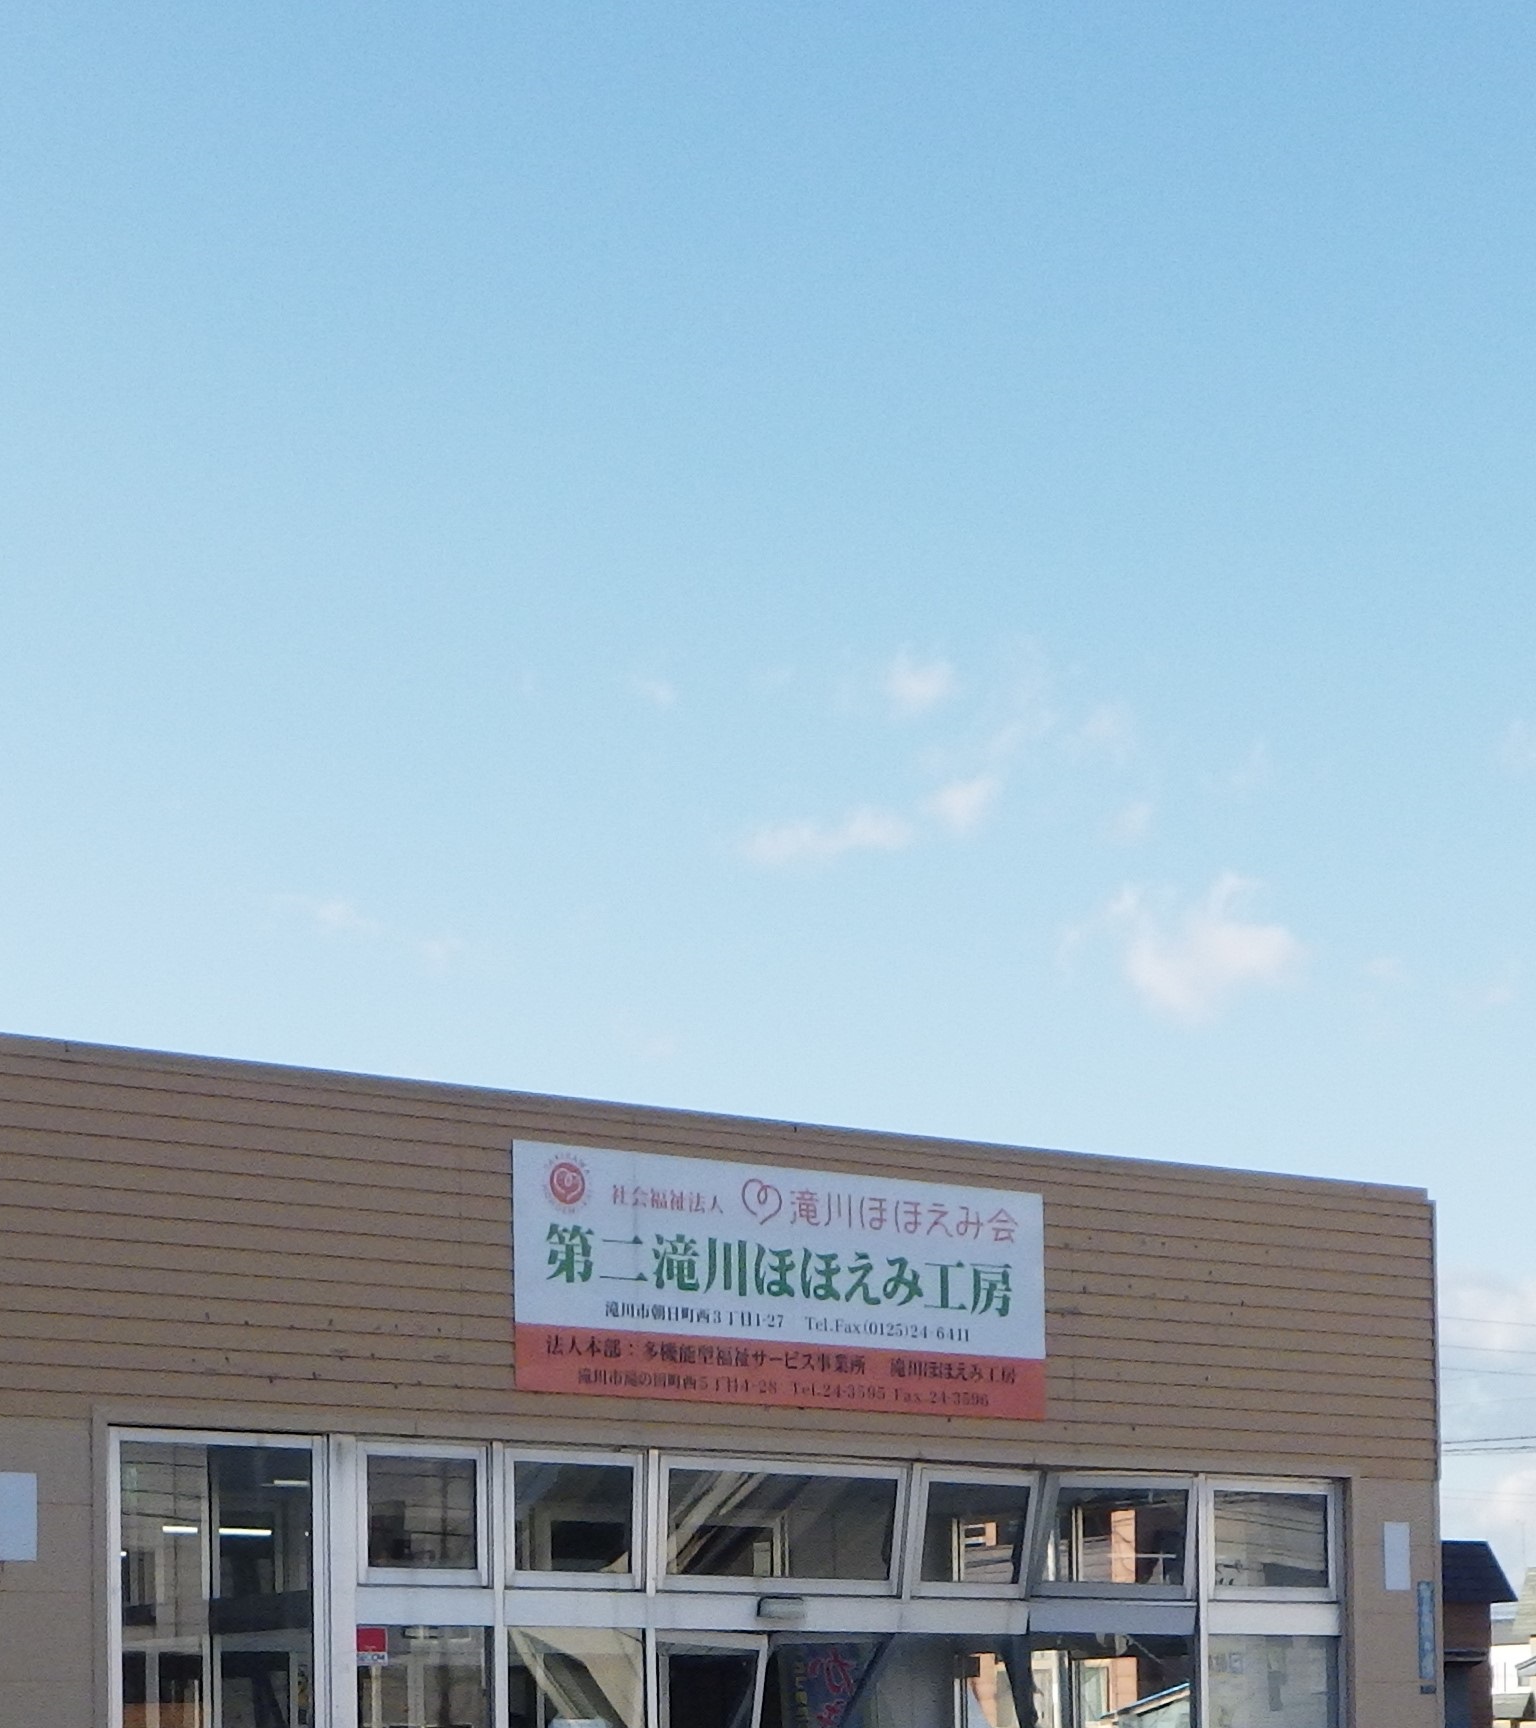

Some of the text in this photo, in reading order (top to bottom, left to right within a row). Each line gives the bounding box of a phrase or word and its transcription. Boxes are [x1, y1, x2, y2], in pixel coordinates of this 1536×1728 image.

[612, 1184, 724, 1215] 社会福祉法人
[789, 1187, 1019, 1244] 滝川ほほえみ会
[545, 1222, 1014, 1318] 第二滝川ほほえみ工房
